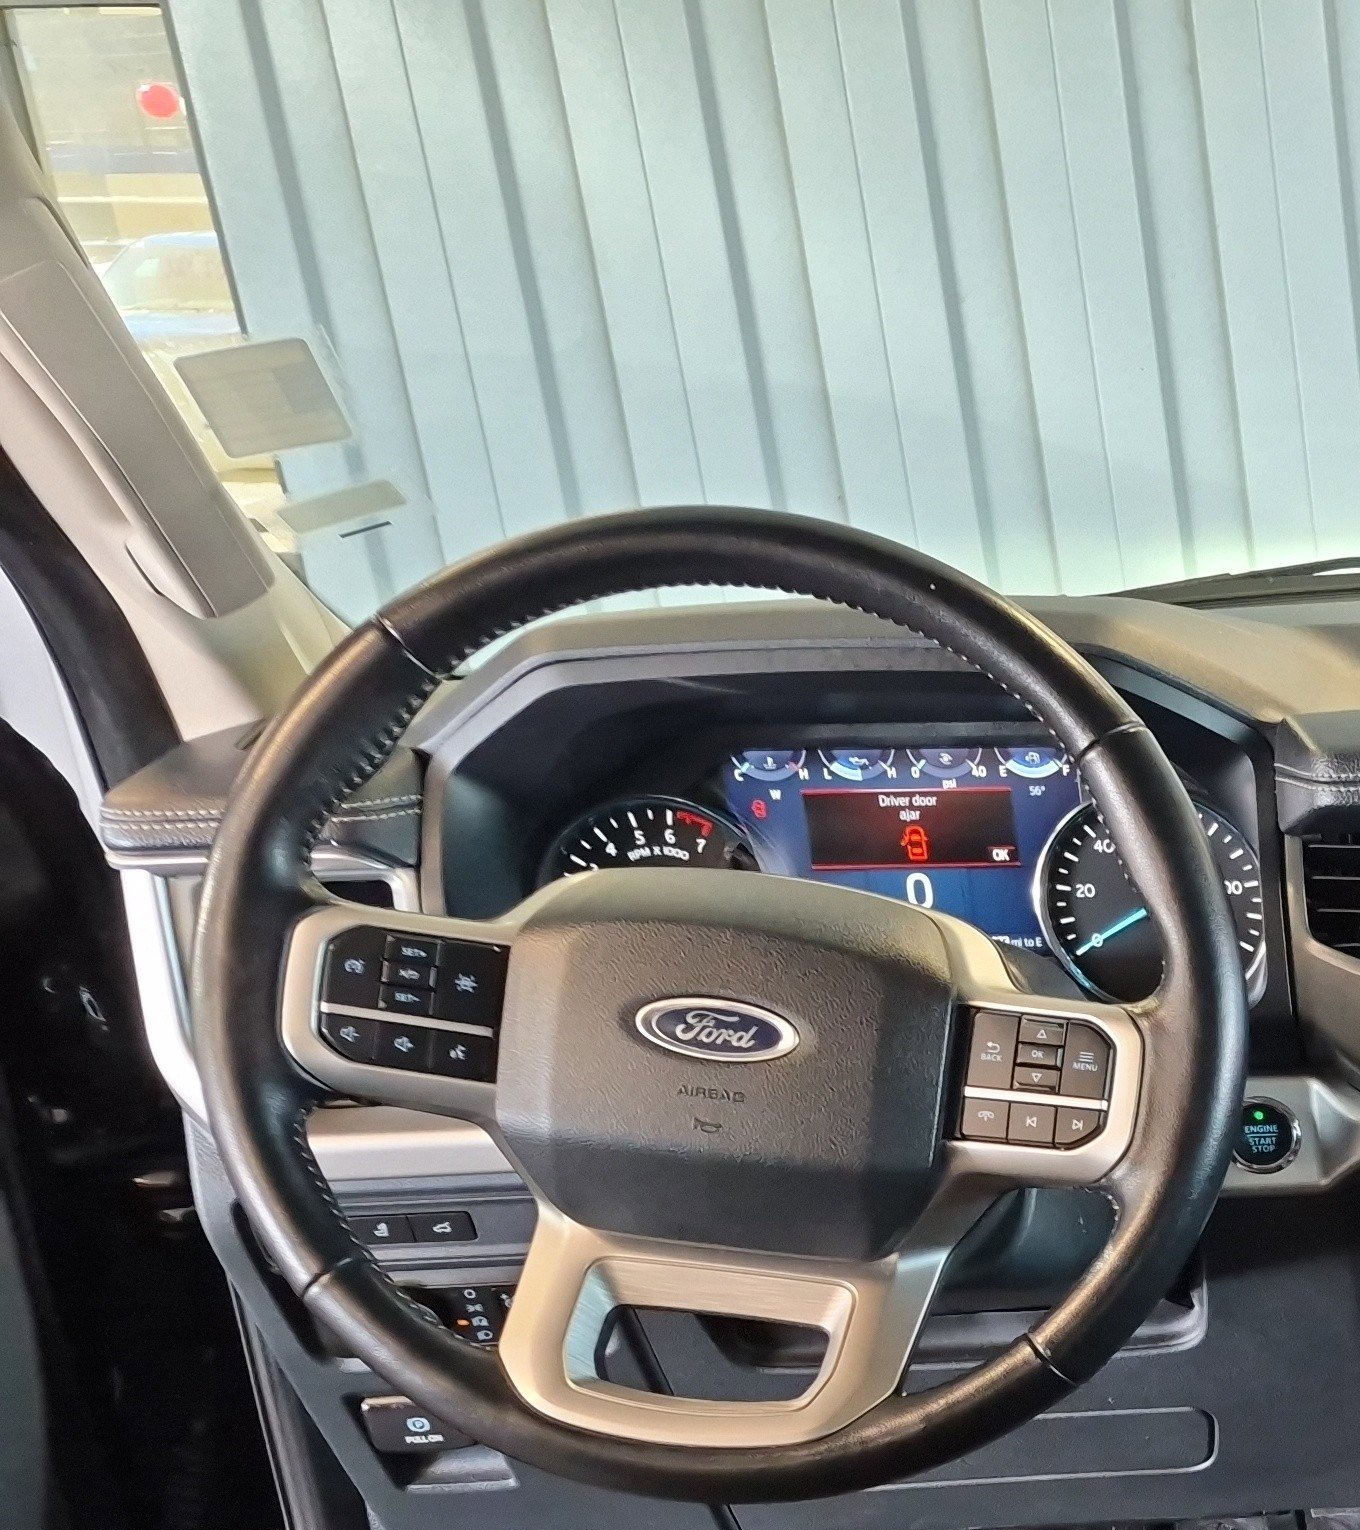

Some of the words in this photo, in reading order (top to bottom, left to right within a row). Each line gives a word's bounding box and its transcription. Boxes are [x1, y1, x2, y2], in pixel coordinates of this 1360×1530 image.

[878, 795, 910, 807] Driver
[912, 794, 938, 807] door
[899, 809, 921, 821] ajar
[634, 830, 646, 845] 5
[664, 829, 676, 844] 6
[605, 841, 617, 857] 4
[695, 838, 707, 854] 7
[1093, 839, 1115, 853] 40
[627, 846, 652, 862] RPM
[662, 845, 690, 861] 1000
[992, 849, 1010, 862] OK
[906, 872, 934, 909] 0
[1076, 884, 1096, 898] 20
[675, 1010, 759, 1048] Ford
[980, 1053, 1002, 1062] BACK
[1031, 1050, 1045, 1058] OK
[1072, 1062, 1098, 1072] MENU
[1244, 1124, 1279, 1133] ENGINE
[1249, 1136, 1276, 1145] START
[1252, 1145, 1276, 1153] STOP
